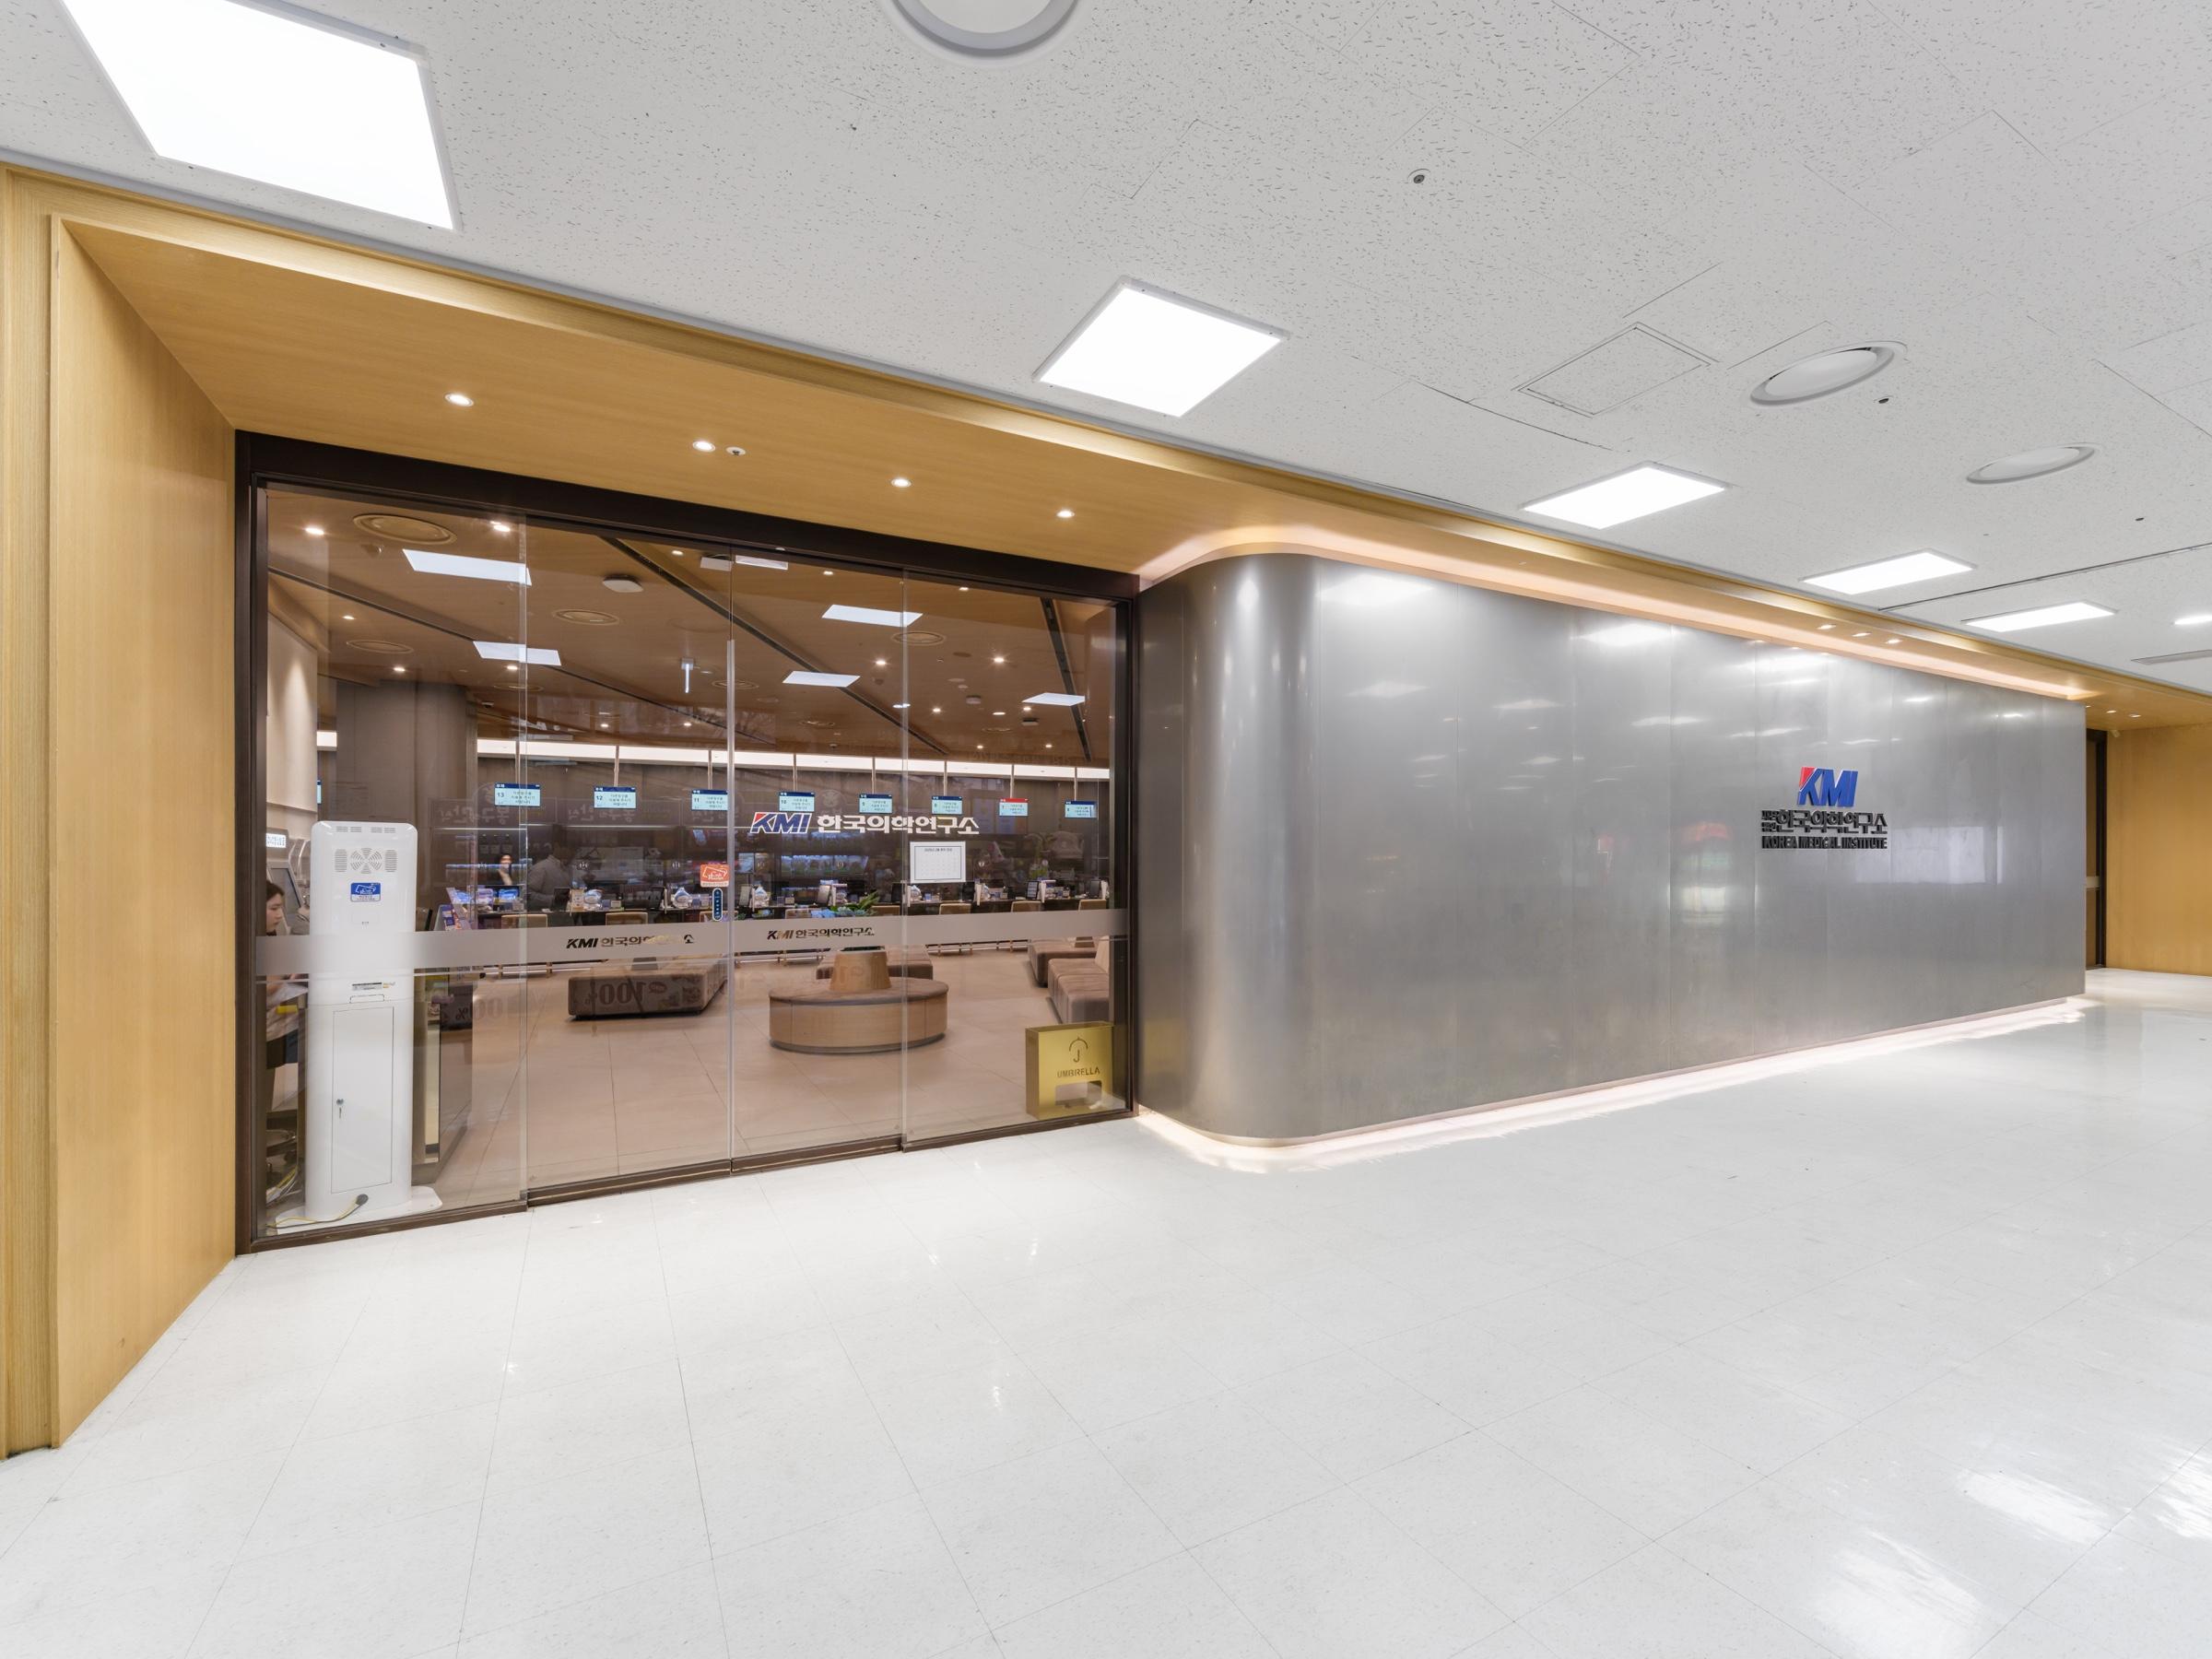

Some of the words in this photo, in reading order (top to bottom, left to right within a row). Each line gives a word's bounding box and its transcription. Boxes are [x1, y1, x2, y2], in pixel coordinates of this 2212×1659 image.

[1797, 766, 1858, 807] KMI
[749, 812, 812, 834] KMI
[817, 815, 980, 834] 한국의학연구소
[1776, 809, 1888, 834] 한국의학연구소
[1761, 835, 1798, 849] KOREA
[1798, 836, 1841, 849] MEDICAL
[1841, 837, 1888, 849] INSTITUTE
[767, 930, 794, 940] KMI
[795, 926, 875, 939] 한국의학연구소
[566, 937, 599, 949] KMI
[1056, 1066, 1100, 1078] UMBRELLA
